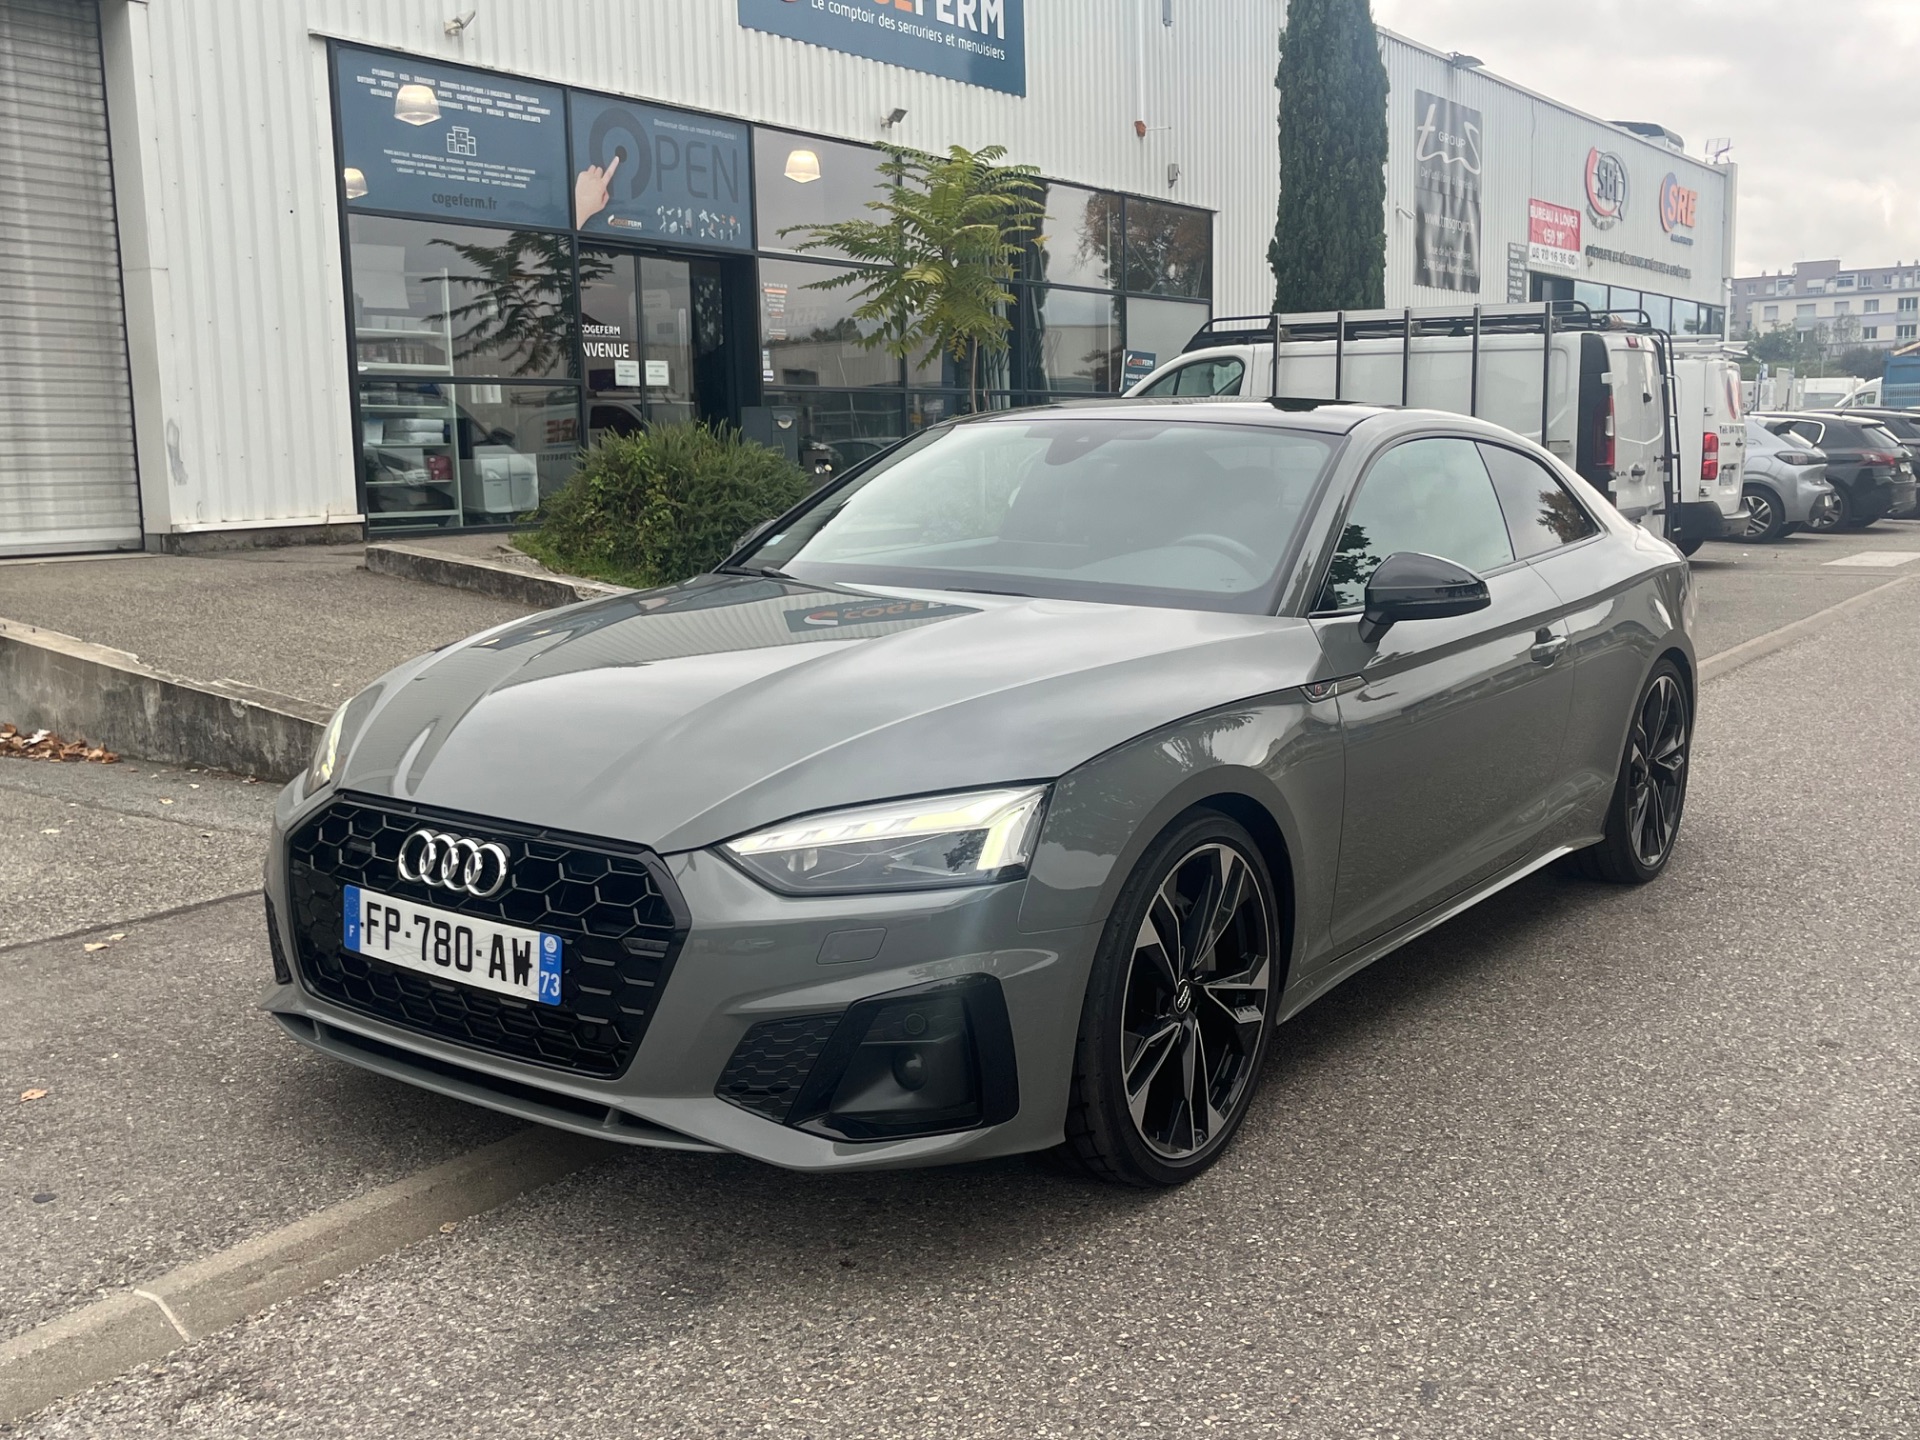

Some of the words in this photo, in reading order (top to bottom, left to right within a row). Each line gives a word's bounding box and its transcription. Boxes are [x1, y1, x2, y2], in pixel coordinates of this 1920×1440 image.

[828, 1, 875, 24] comptoir
[878, 12, 896, 31] des
[898, 20, 943, 43] serruriers
[945, 33, 955, 47] et
[958, 37, 1005, 61] menuisiers
[1438, 131, 1466, 148] GROUP
[432, 192, 497, 210] cogeferm.fr
[1668, 183, 1697, 228] SRE
[1530, 205, 1553, 223] BUREAU
[1560, 212, 1578, 229] LOUER
[1543, 228, 1555, 245] 150
[582, 342, 630, 358] NVENUE
[349, 924, 355, 938] F
[365, 901, 531, 987] FP-780-AW
[540, 971, 560, 998] 73
